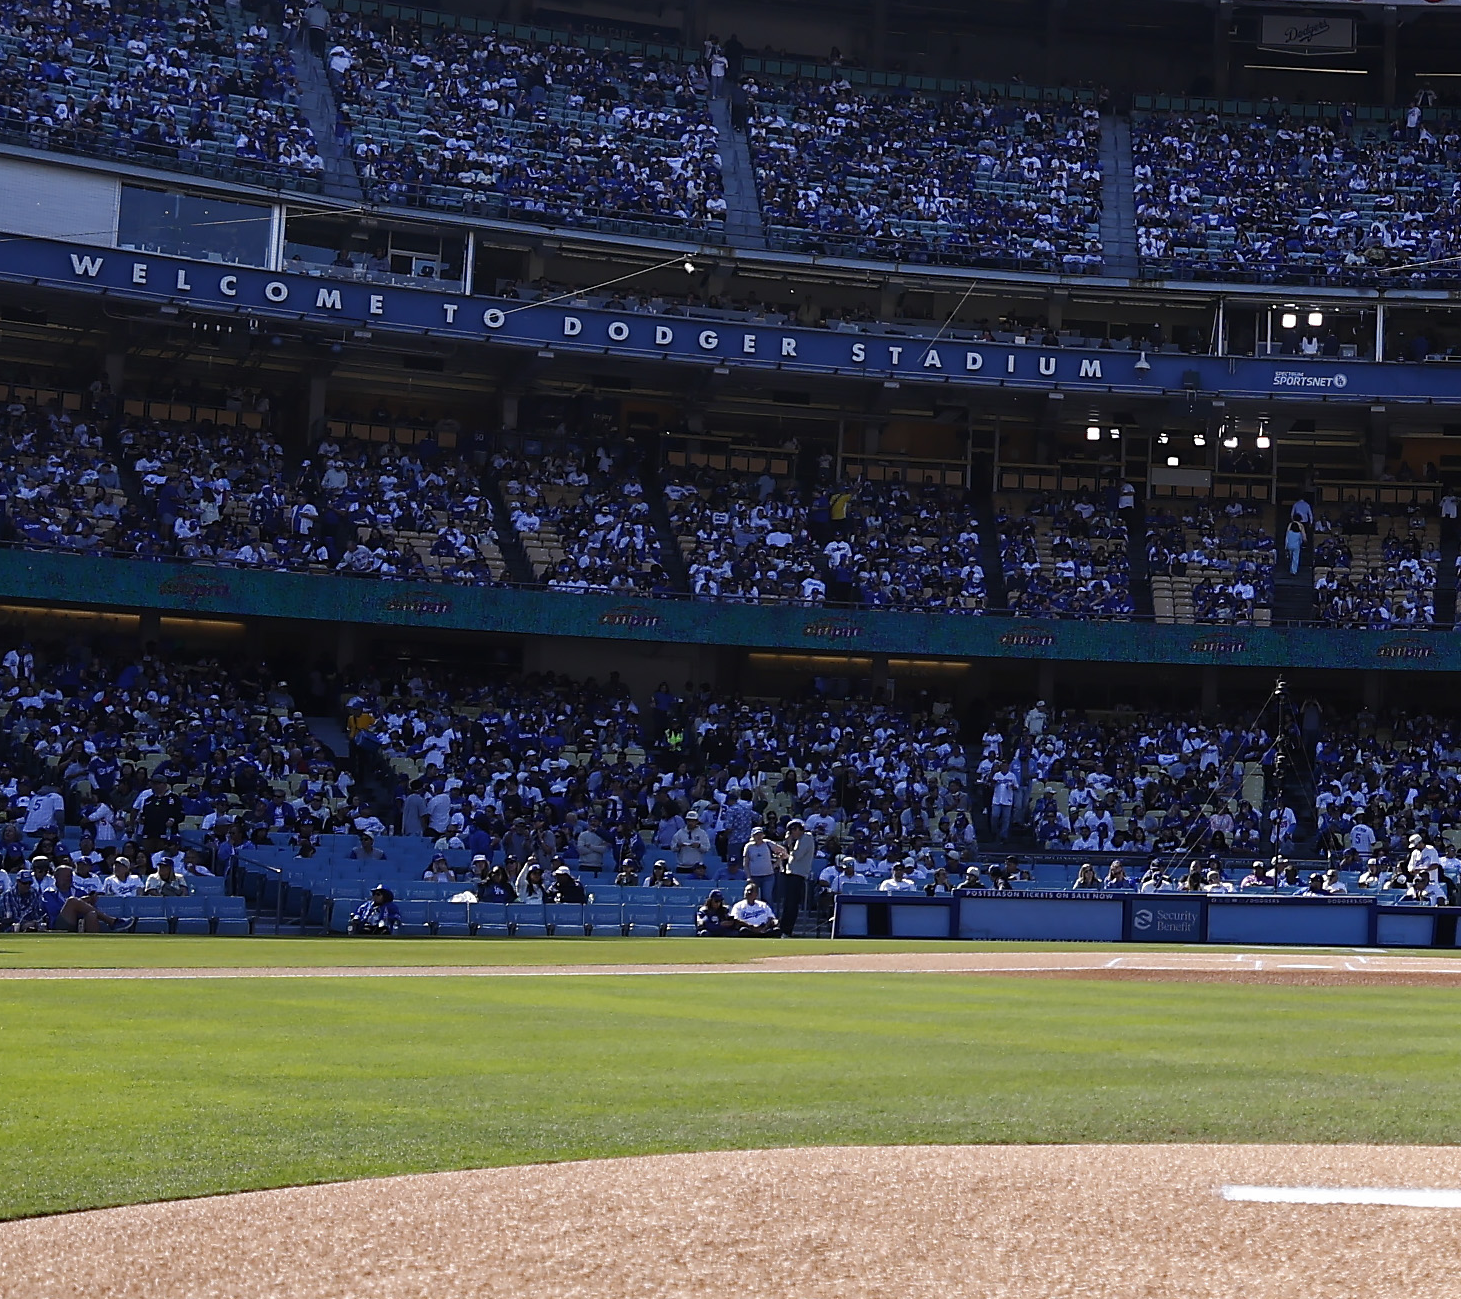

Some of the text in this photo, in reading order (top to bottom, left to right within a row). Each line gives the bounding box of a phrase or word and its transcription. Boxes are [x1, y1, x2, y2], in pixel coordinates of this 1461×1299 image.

[69, 253, 1104, 380] WELCOME TO DODGER STADIUM
[1272, 376, 1334, 387] SPORTSNET
[34, 799, 43, 812] 5
[965, 890, 1020, 898] POSTSEASON
[1156, 910, 1198, 922] Security
[1156, 920, 1191, 932] Benefit
